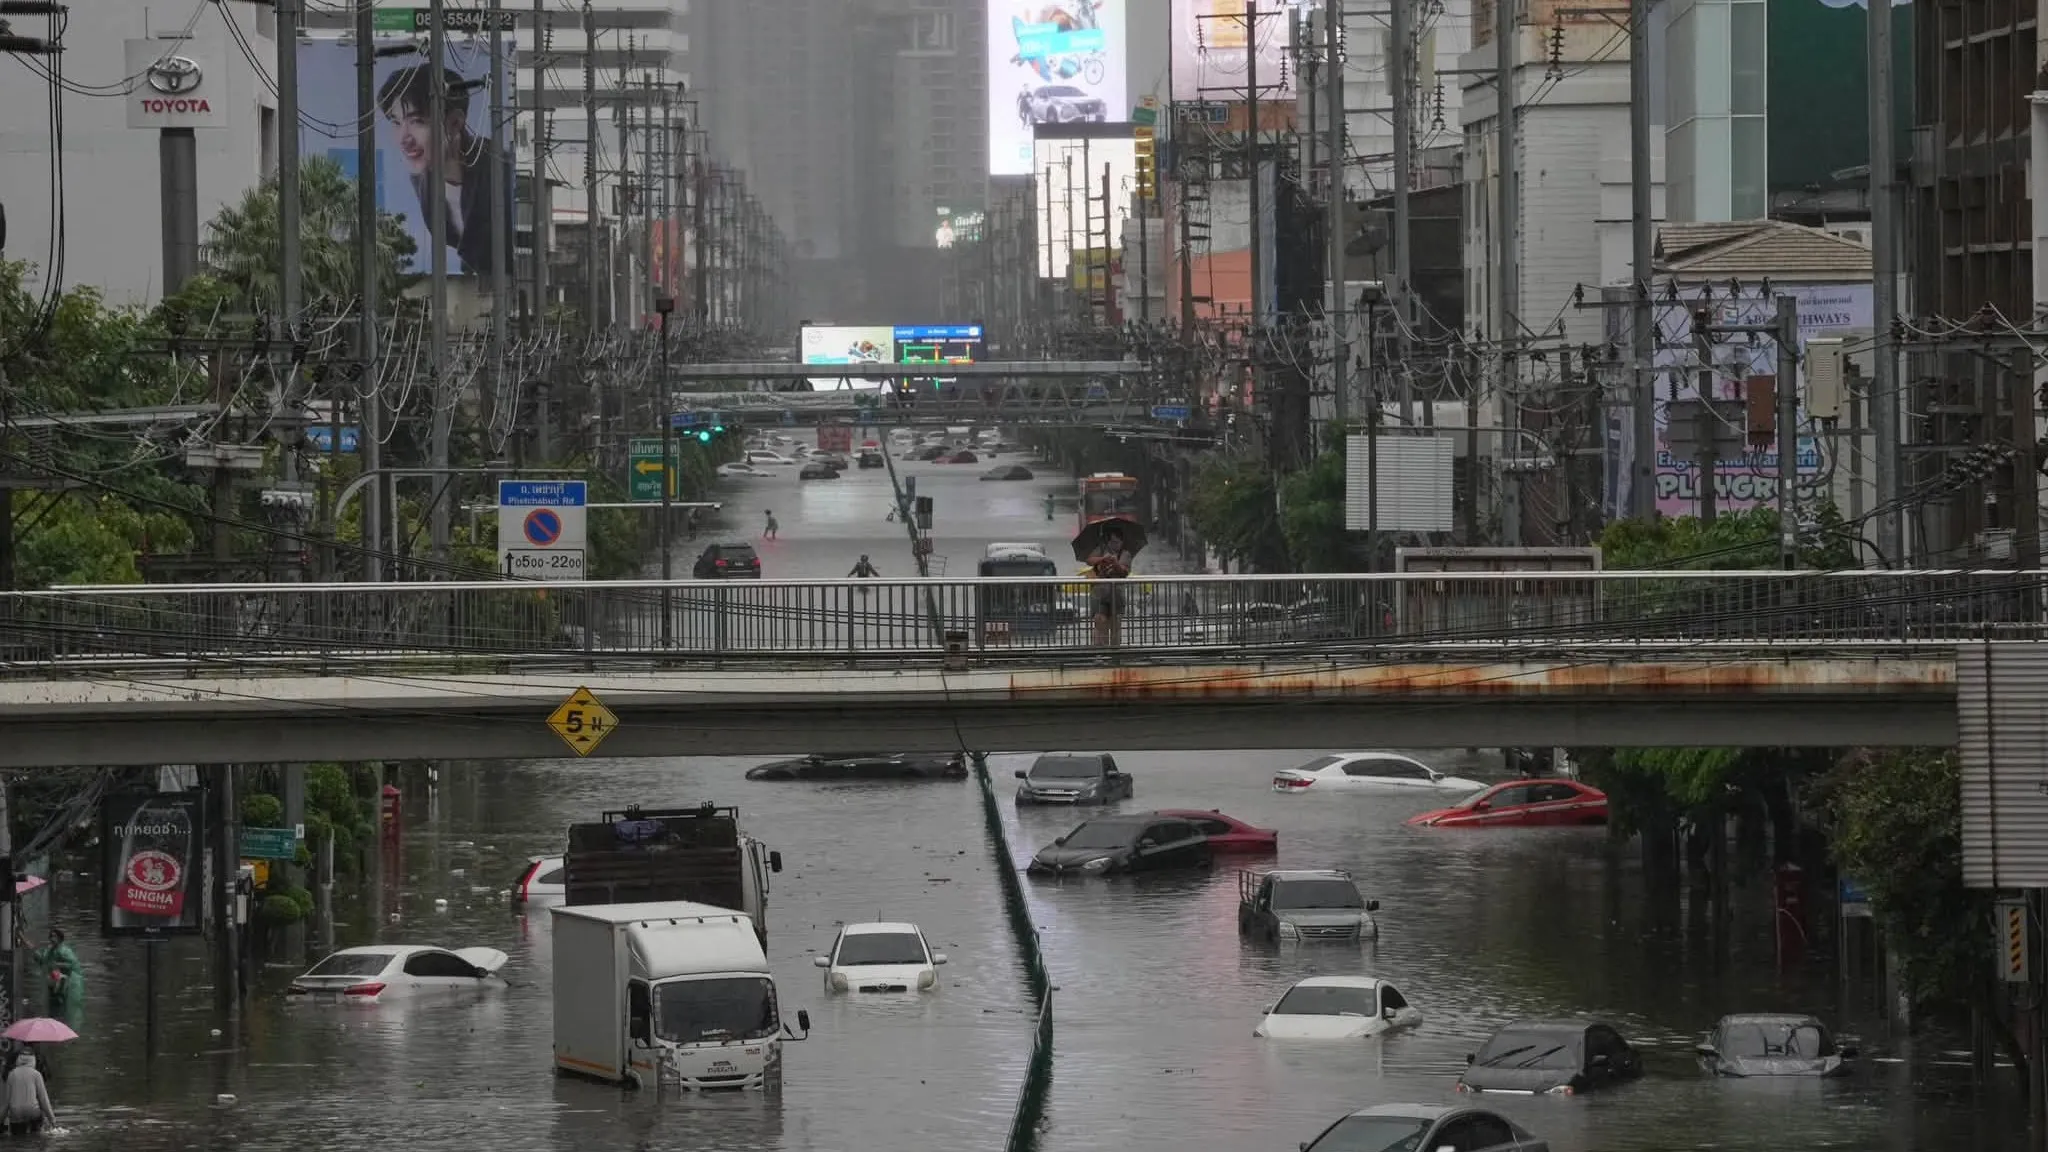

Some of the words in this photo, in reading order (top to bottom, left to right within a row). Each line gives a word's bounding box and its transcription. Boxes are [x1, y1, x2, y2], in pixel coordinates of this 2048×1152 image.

[141, 99, 211, 113] TOYOTA
[566, 709, 584, 733] 5
[127, 888, 173, 905] SINGHA
